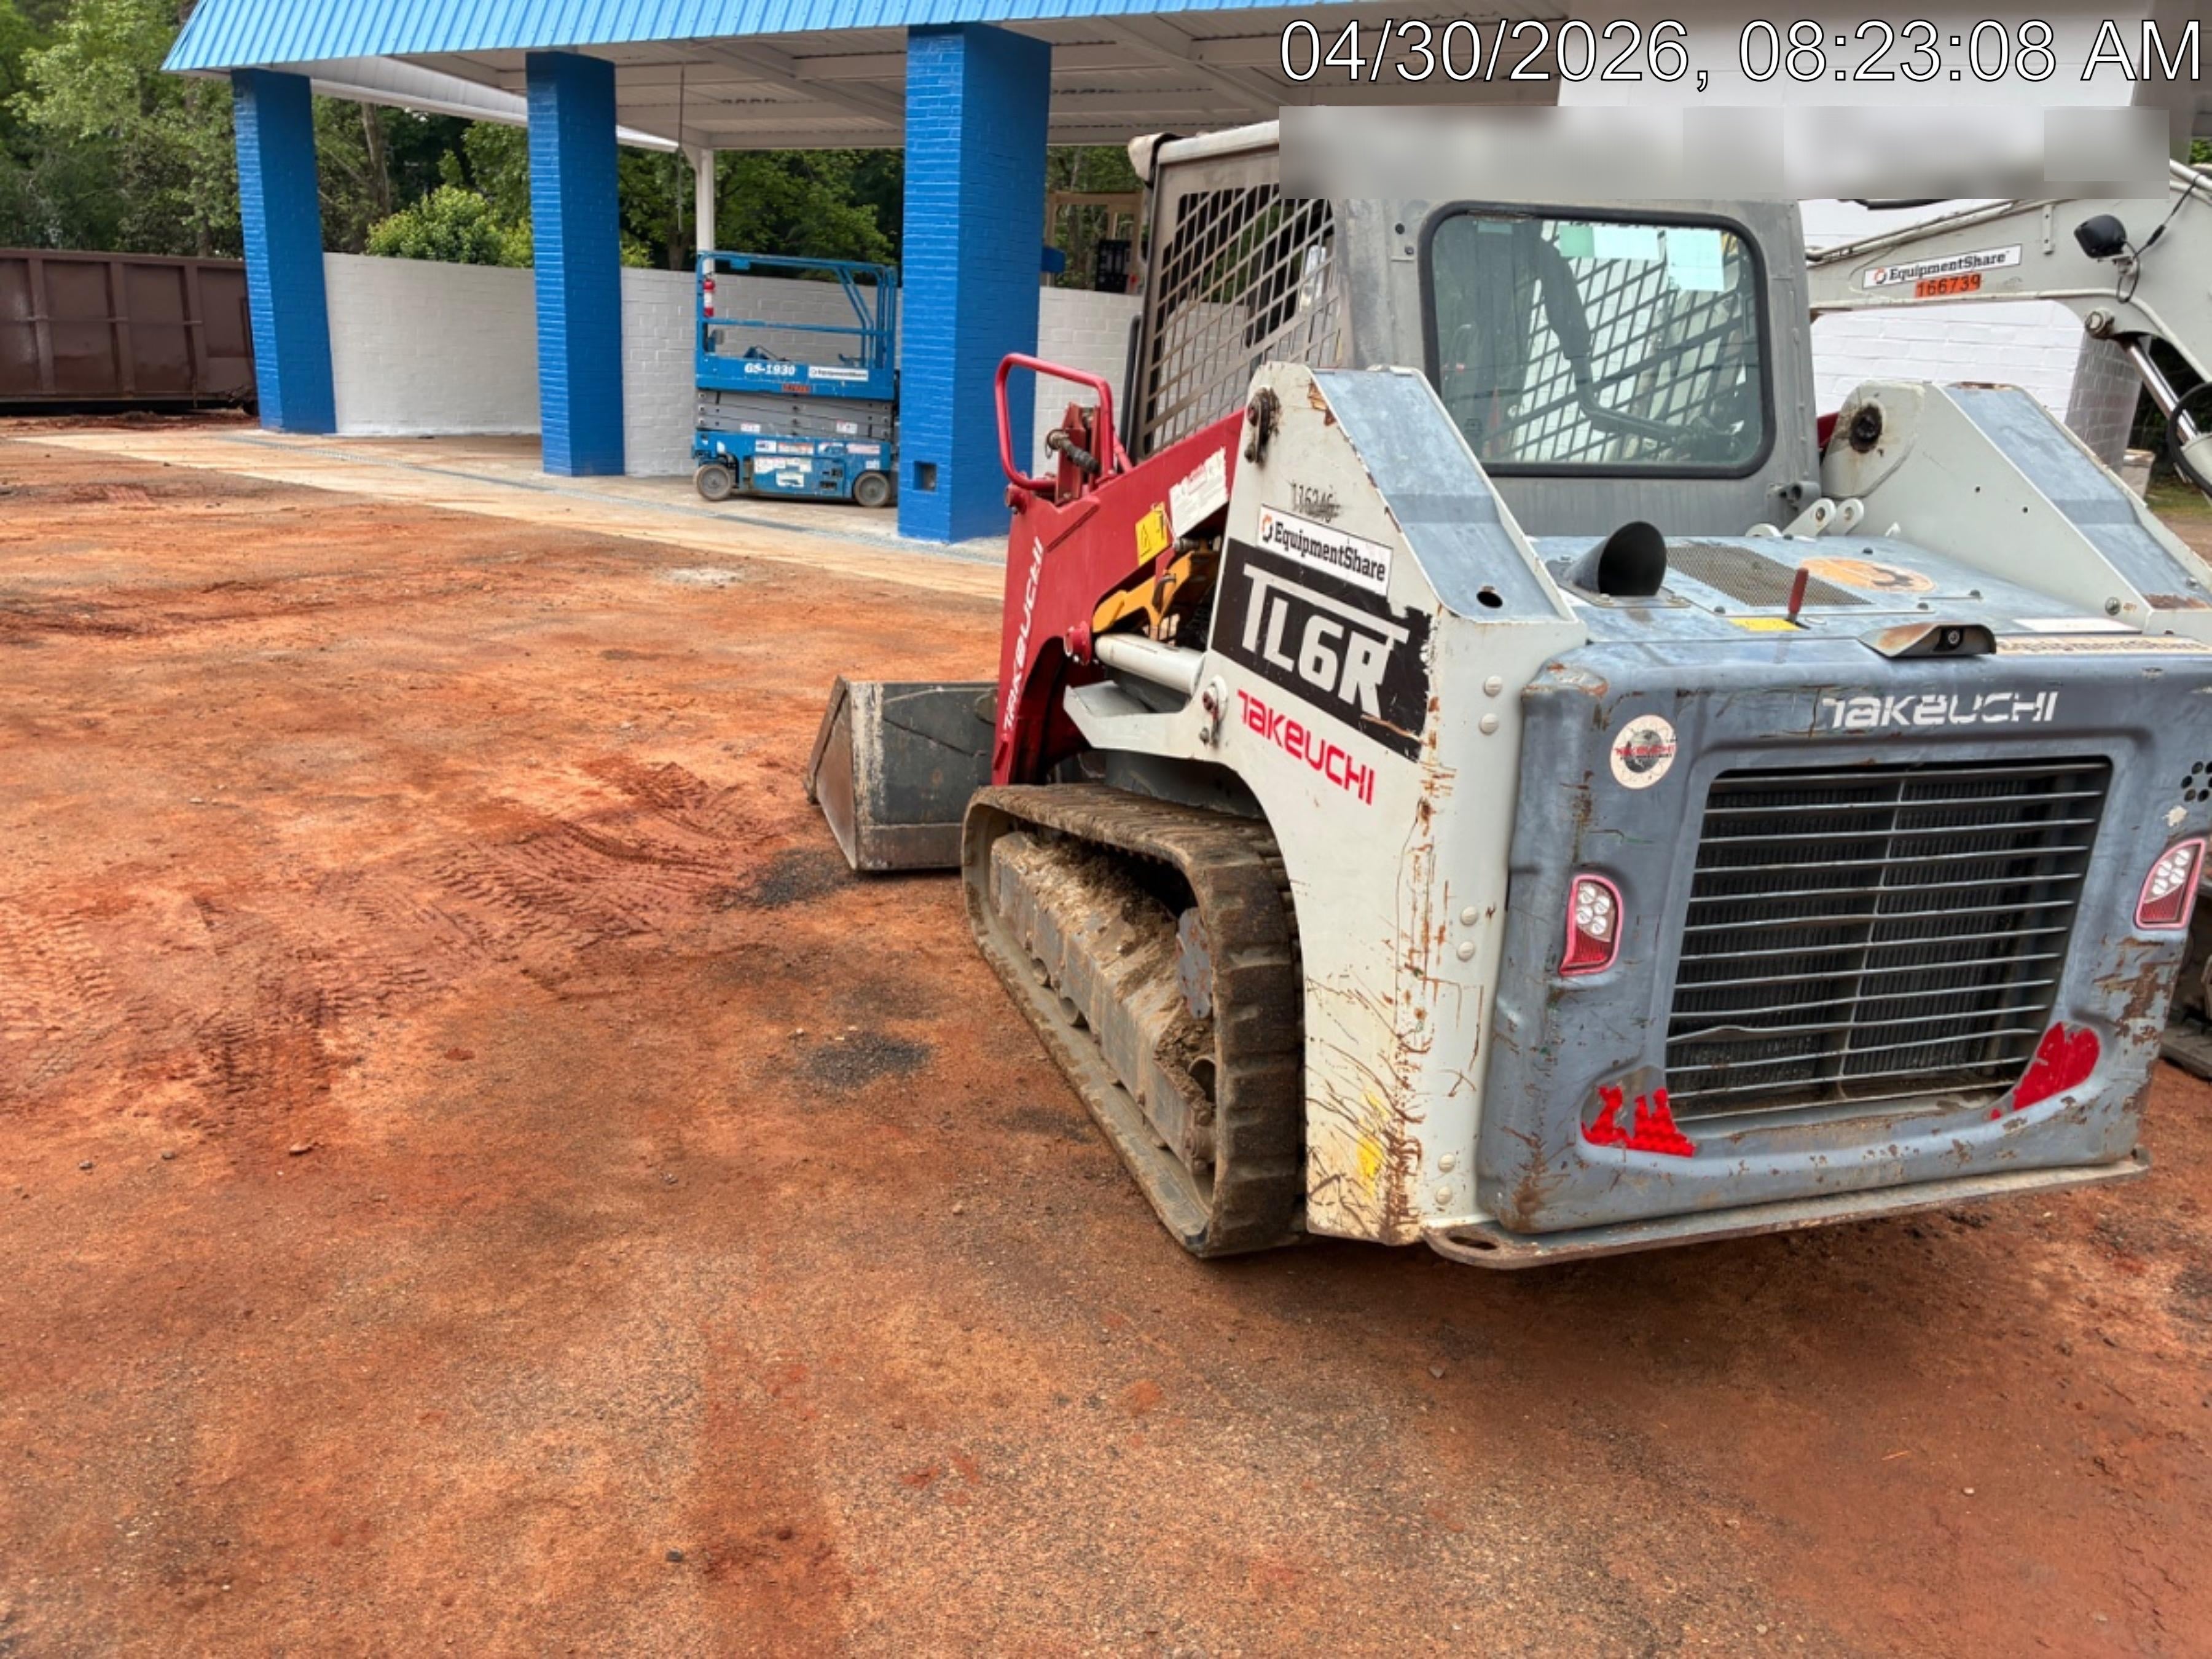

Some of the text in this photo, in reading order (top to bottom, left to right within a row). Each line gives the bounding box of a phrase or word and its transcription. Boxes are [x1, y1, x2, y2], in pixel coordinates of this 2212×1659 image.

[1889, 253, 2007, 280] EquipmentShare
[1916, 273, 1980, 297] 166739
[744, 363, 796, 375] GS-1930
[1274, 521, 1386, 583] EquipmentShare
[1242, 563, 1410, 720] TL6R
